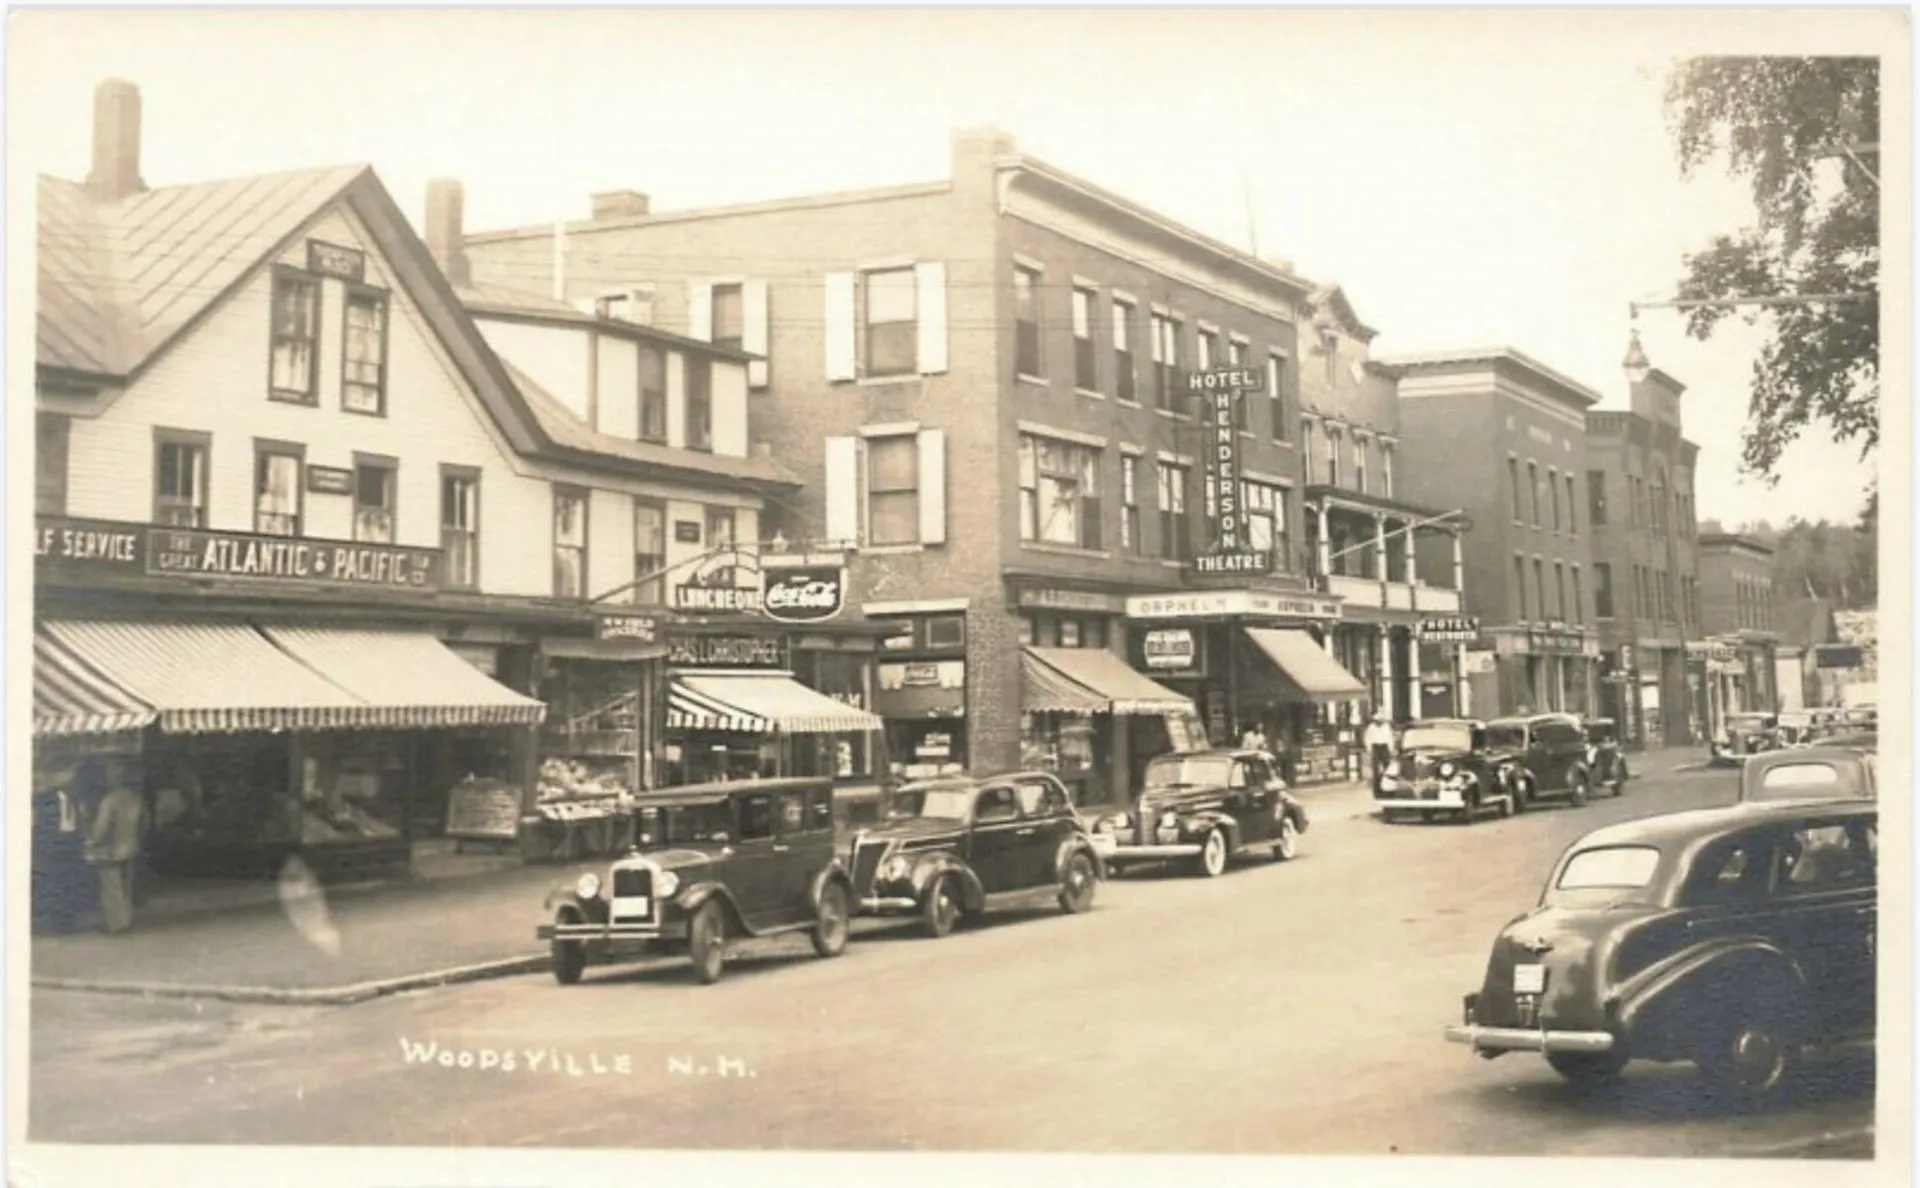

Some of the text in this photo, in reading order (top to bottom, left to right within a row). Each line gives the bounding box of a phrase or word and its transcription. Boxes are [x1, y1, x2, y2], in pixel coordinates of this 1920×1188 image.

[1189, 370, 1255, 389] HOTEL
[1216, 393, 1236, 549] HENDERSON
[62, 529, 136, 562] SERVICE
[202, 537, 308, 576] ATLANTIC
[332, 547, 408, 584] PACIFIC
[1197, 553, 1265, 572] THEATRE
